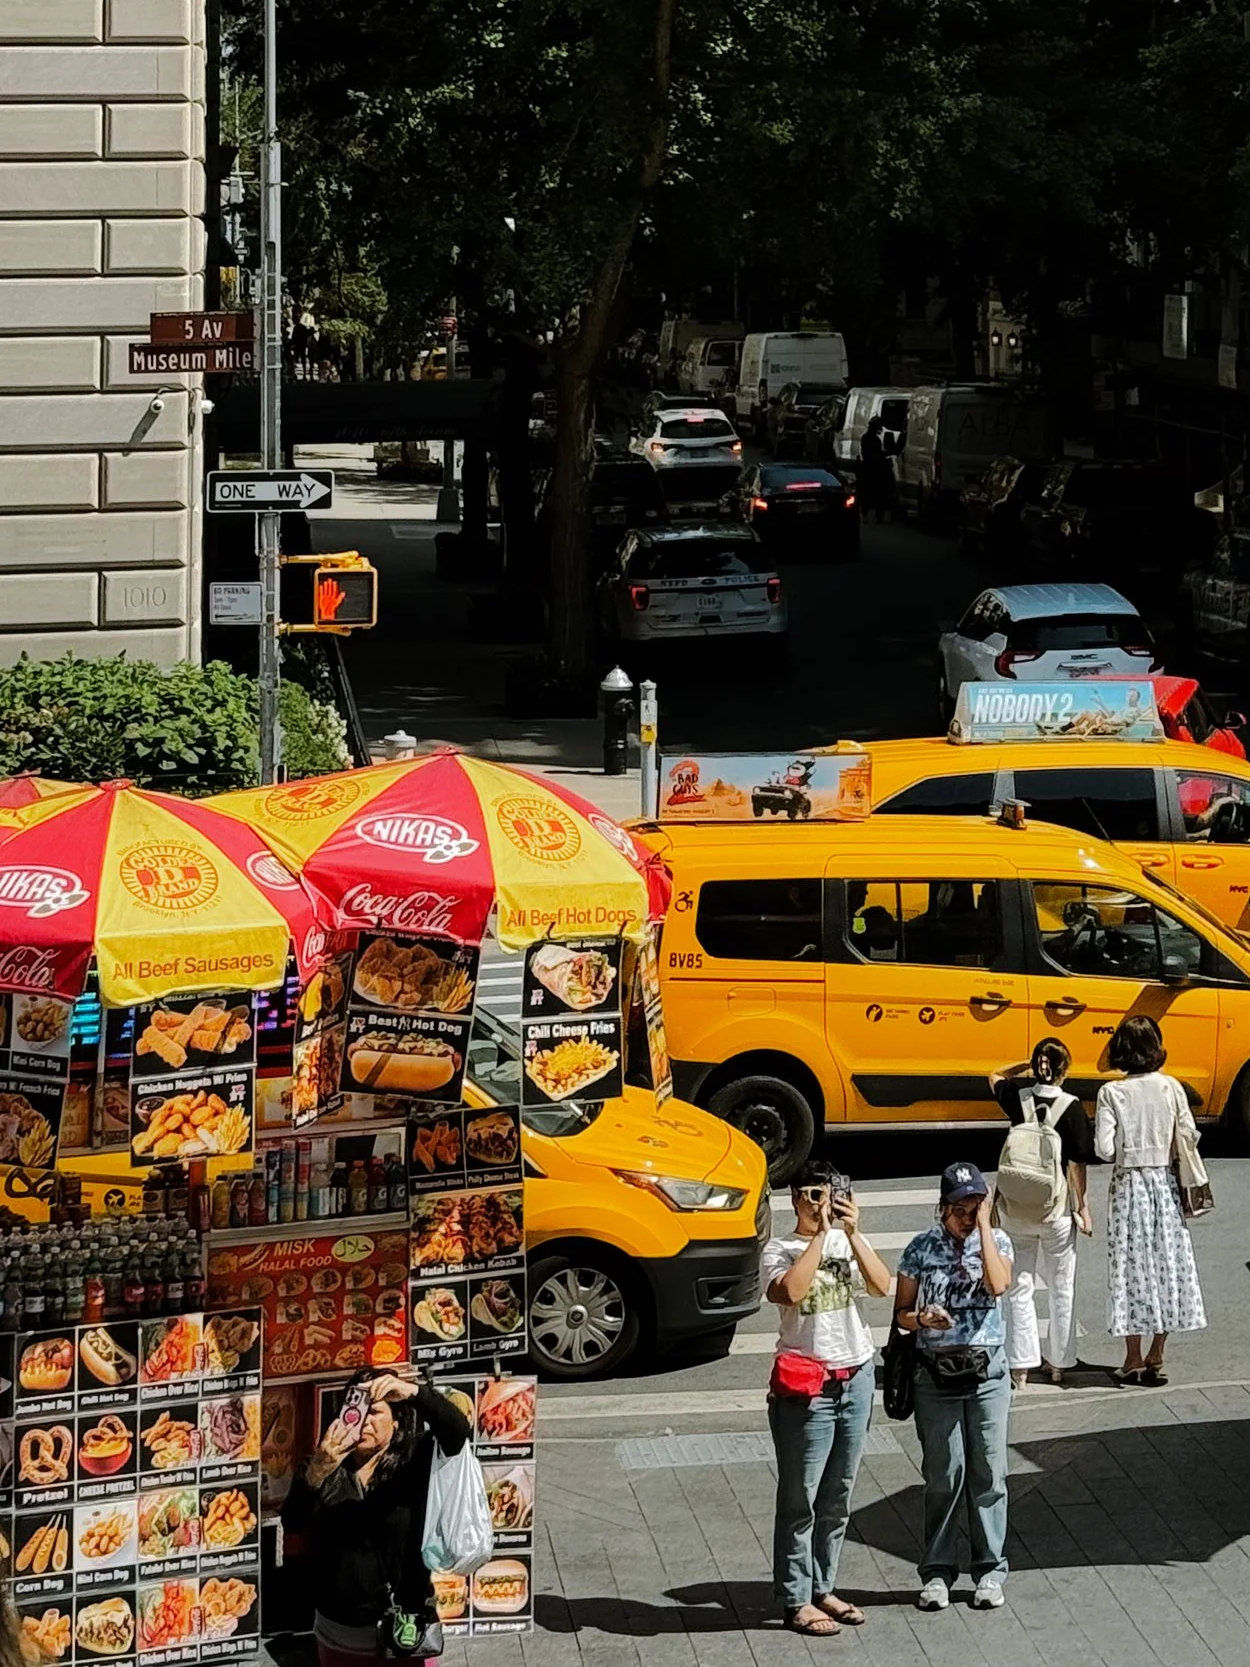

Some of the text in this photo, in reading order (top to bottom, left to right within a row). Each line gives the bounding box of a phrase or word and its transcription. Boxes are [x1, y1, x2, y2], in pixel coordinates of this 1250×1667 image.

[184, 320, 223, 340] 5 Av
[133, 349, 251, 370] Museum Mile
[220, 484, 316, 499] ONE WAY
[123, 588, 167, 608] 1010
[974, 693, 1074, 724] NOBODY 2
[372, 819, 453, 846] NIKAS
[340, 884, 463, 932] Coca-Cola
[507, 906, 638, 927] All Beef Hot Dogs
[112, 953, 275, 981] All Beef Sausages
[669, 953, 703, 969] 8V85
[368, 1014, 463, 1035] Best Hot Dog
[528, 1021, 616, 1039] Chili Cheese Fries
[47, 1059, 61, 1072] Dog
[137, 1083, 174, 1095] Chicken
[175, 1078, 212, 1091] Nuggets
[226, 1073, 248, 1083] Fries
[273, 1239, 316, 1257] MISK
[334, 1237, 372, 1258] حلال
[258, 1255, 333, 1274] HALAL FOOD
[419, 1257, 517, 1278] Halal Chicken Kebab
[417, 1338, 519, 1360] Mix Gyro Lamb Gyro
[23, 1488, 69, 1505] Pretzel
[16, 1579, 64, 1594] Corn Dog
